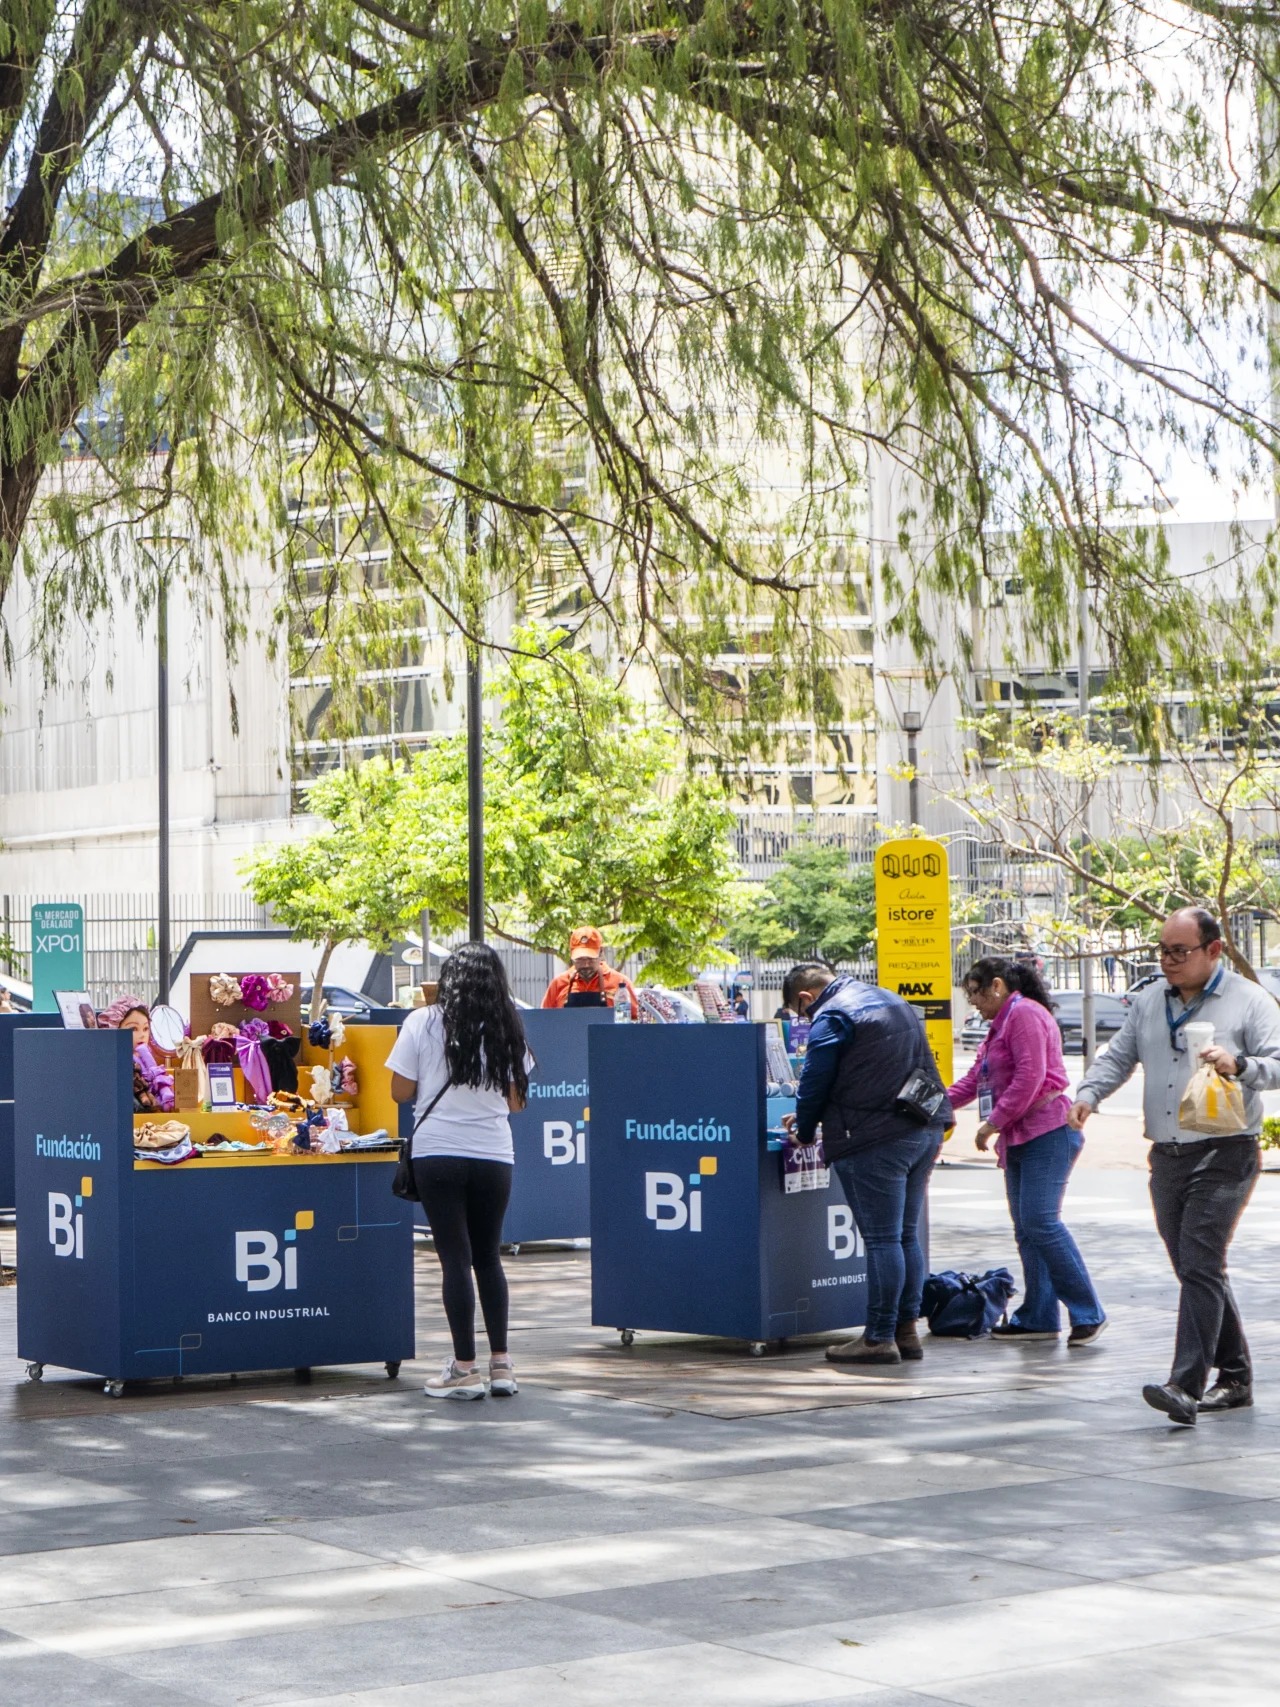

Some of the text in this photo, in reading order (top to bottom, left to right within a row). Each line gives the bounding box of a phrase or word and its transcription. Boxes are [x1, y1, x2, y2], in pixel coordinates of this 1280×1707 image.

[35, 910, 79, 920] EL MERCADO
[888, 907, 934, 920] istore
[898, 982, 933, 995] MAX
[529, 1079, 590, 1098] Fundaci
[625, 1117, 731, 1142] Fundación
[36, 1133, 101, 1161] Fundación
[543, 1119, 586, 1166] Bi
[645, 1171, 702, 1232] Bi
[48, 1191, 84, 1260] Bi
[235, 1228, 298, 1292] Bi
[811, 1273, 867, 1288] BANCO INDUST
[207, 1307, 330, 1323] BANCO INDUSTRIAL
